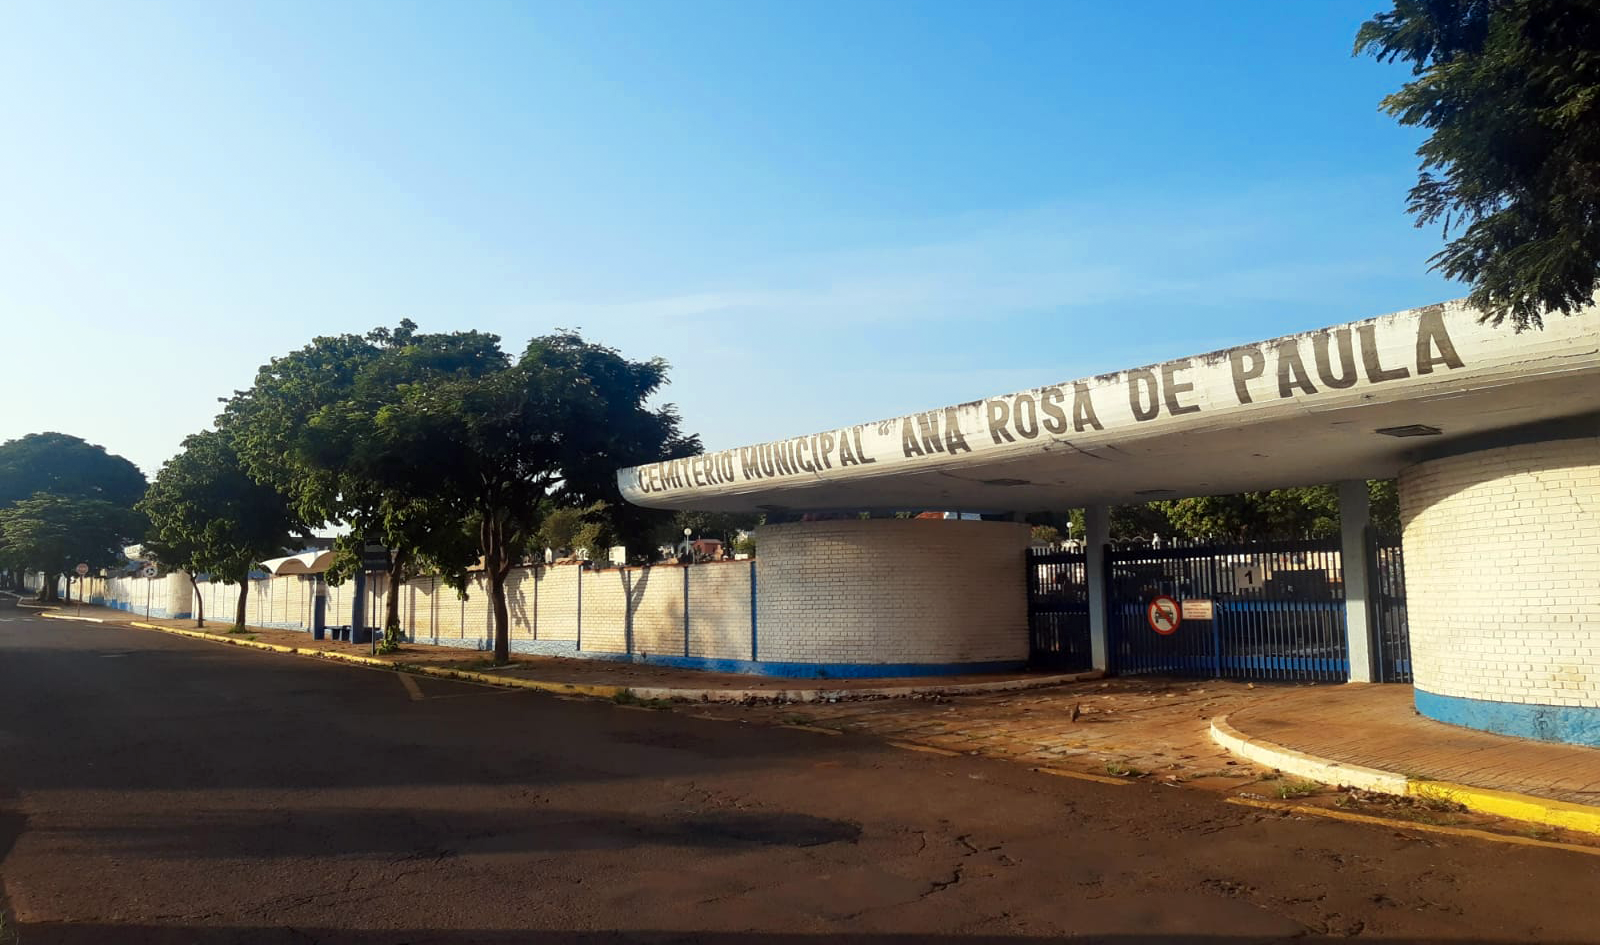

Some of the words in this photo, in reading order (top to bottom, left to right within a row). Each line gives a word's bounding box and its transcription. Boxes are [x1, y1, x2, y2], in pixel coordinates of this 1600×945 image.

[639, 453, 734, 493] CEMITERIO
[740, 427, 875, 480] MUNICIPAL
[987, 383, 1104, 444] ROSA
[1128, 361, 1200, 422] DE
[1229, 310, 1465, 404] PAULA
[1244, 570, 1253, 585] 1
